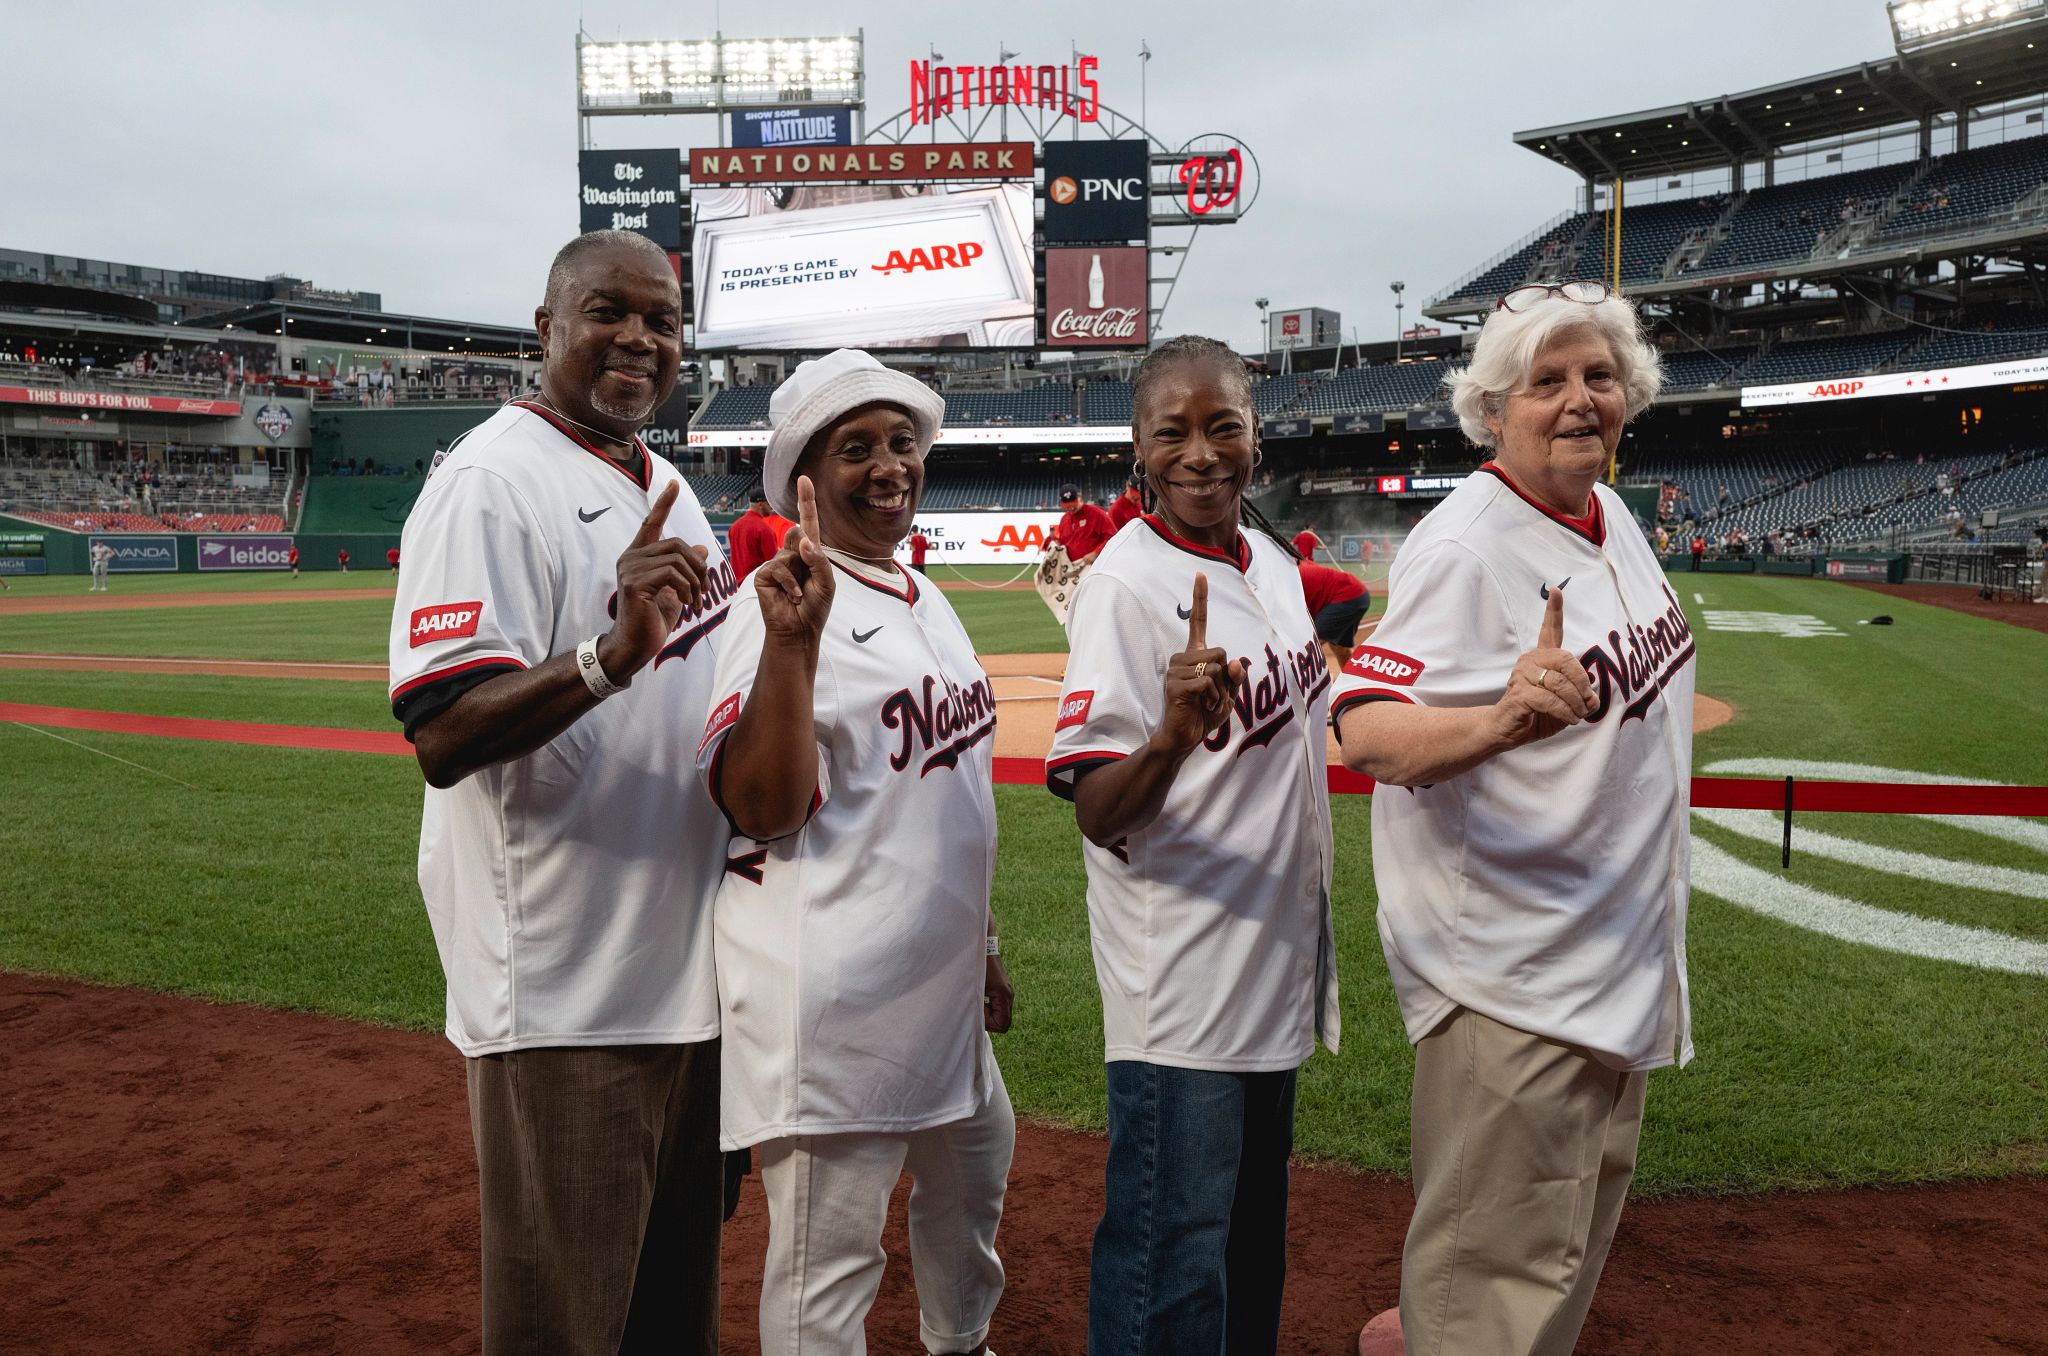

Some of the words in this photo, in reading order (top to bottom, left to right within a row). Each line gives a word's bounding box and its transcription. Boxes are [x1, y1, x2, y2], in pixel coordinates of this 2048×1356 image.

[910, 57, 1098, 125] NATIONALS
[745, 111, 772, 120] SHOW
[774, 110, 800, 119] SOME
[760, 116, 836, 142] NATITUDE
[702, 151, 904, 174] NATIONALS
[925, 150, 1015, 169] PARK
[614, 163, 643, 182] The
[583, 184, 676, 207] Washington
[1081, 178, 1142, 201] PNC
[612, 212, 648, 231] Post
[721, 263, 789, 279] TODAY'S
[794, 258, 838, 271] GAME
[871, 242, 984, 276] AARP
[720, 282, 737, 292] IS
[739, 271, 835, 290] PRESENTED
[839, 268, 858, 280] BY
[1278, 337, 1304, 346] TOYTA
[1992, 368, 2030, 377] TODAY'S
[1808, 381, 1863, 397] AARP
[27, 389, 56, 403] THIS
[60, 391, 97, 405] BUD'S
[100, 395, 123, 407] FOR
[125, 397, 153, 409] YOU.
[1412, 478, 1441, 489] WELCOME
[1442, 478, 1450, 488] TO
[26, 533, 44, 541] office
[945, 541, 965, 550] BY
[113, 547, 170, 557] VANDA
[230, 546, 289, 564] leidos
[412, 611, 472, 636] AARP
[1350, 653, 1412, 679] AARP
